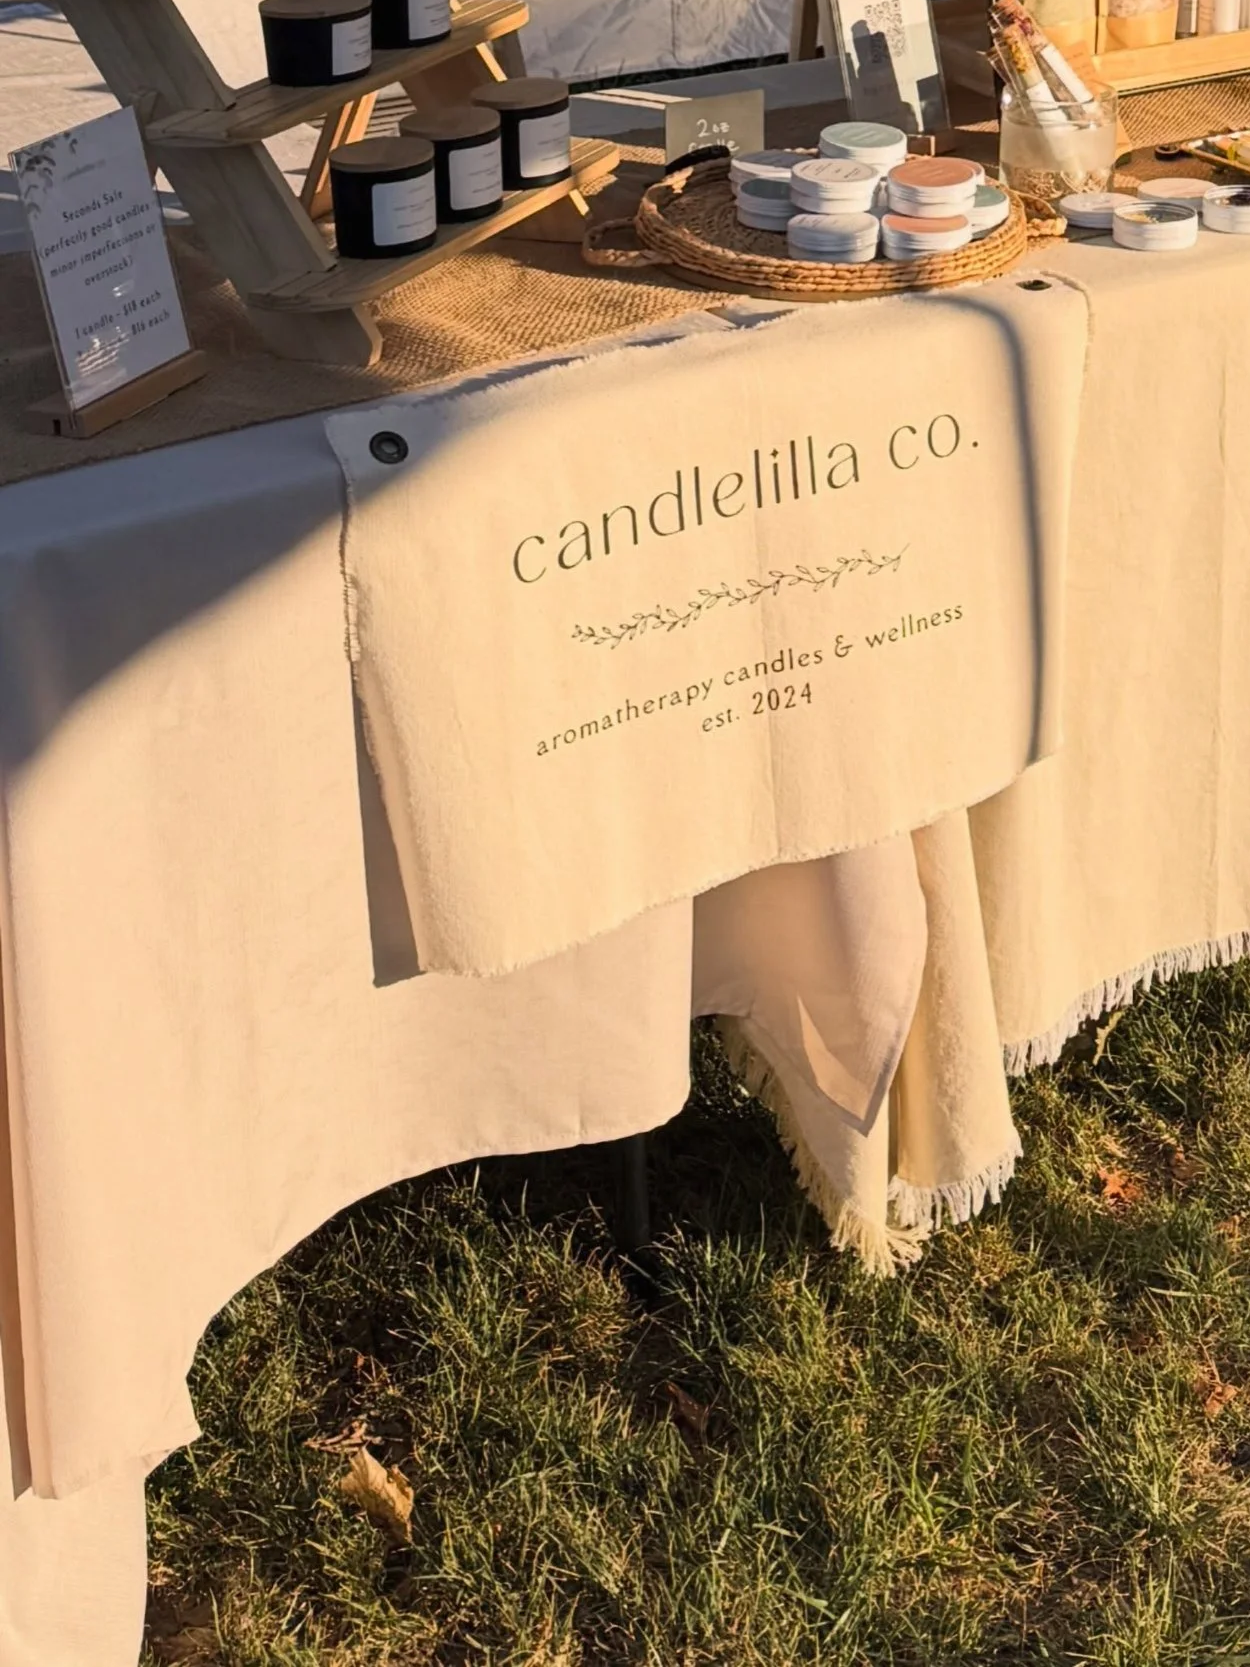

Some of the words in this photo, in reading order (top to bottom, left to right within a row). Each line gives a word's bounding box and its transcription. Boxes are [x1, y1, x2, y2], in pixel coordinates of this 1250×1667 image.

[62, 199, 101, 223] Seconds
[102, 189, 123, 206] Sale
[91, 215, 113, 238] good
[115, 202, 150, 225] candles
[50, 260, 78, 278] minor
[145, 223, 157, 236] or
[82, 313, 114, 337] candle
[140, 289, 161, 308] each
[148, 307, 171, 329] each
[512, 435, 860, 584] candlelilla
[888, 413, 979, 470] co.
[535, 677, 714, 757] aromatherapy
[723, 649, 824, 687] candles
[834, 634, 854, 658] &
[865, 604, 965, 650] wellness
[701, 708, 741, 733] est.
[751, 682, 814, 716] 2024
